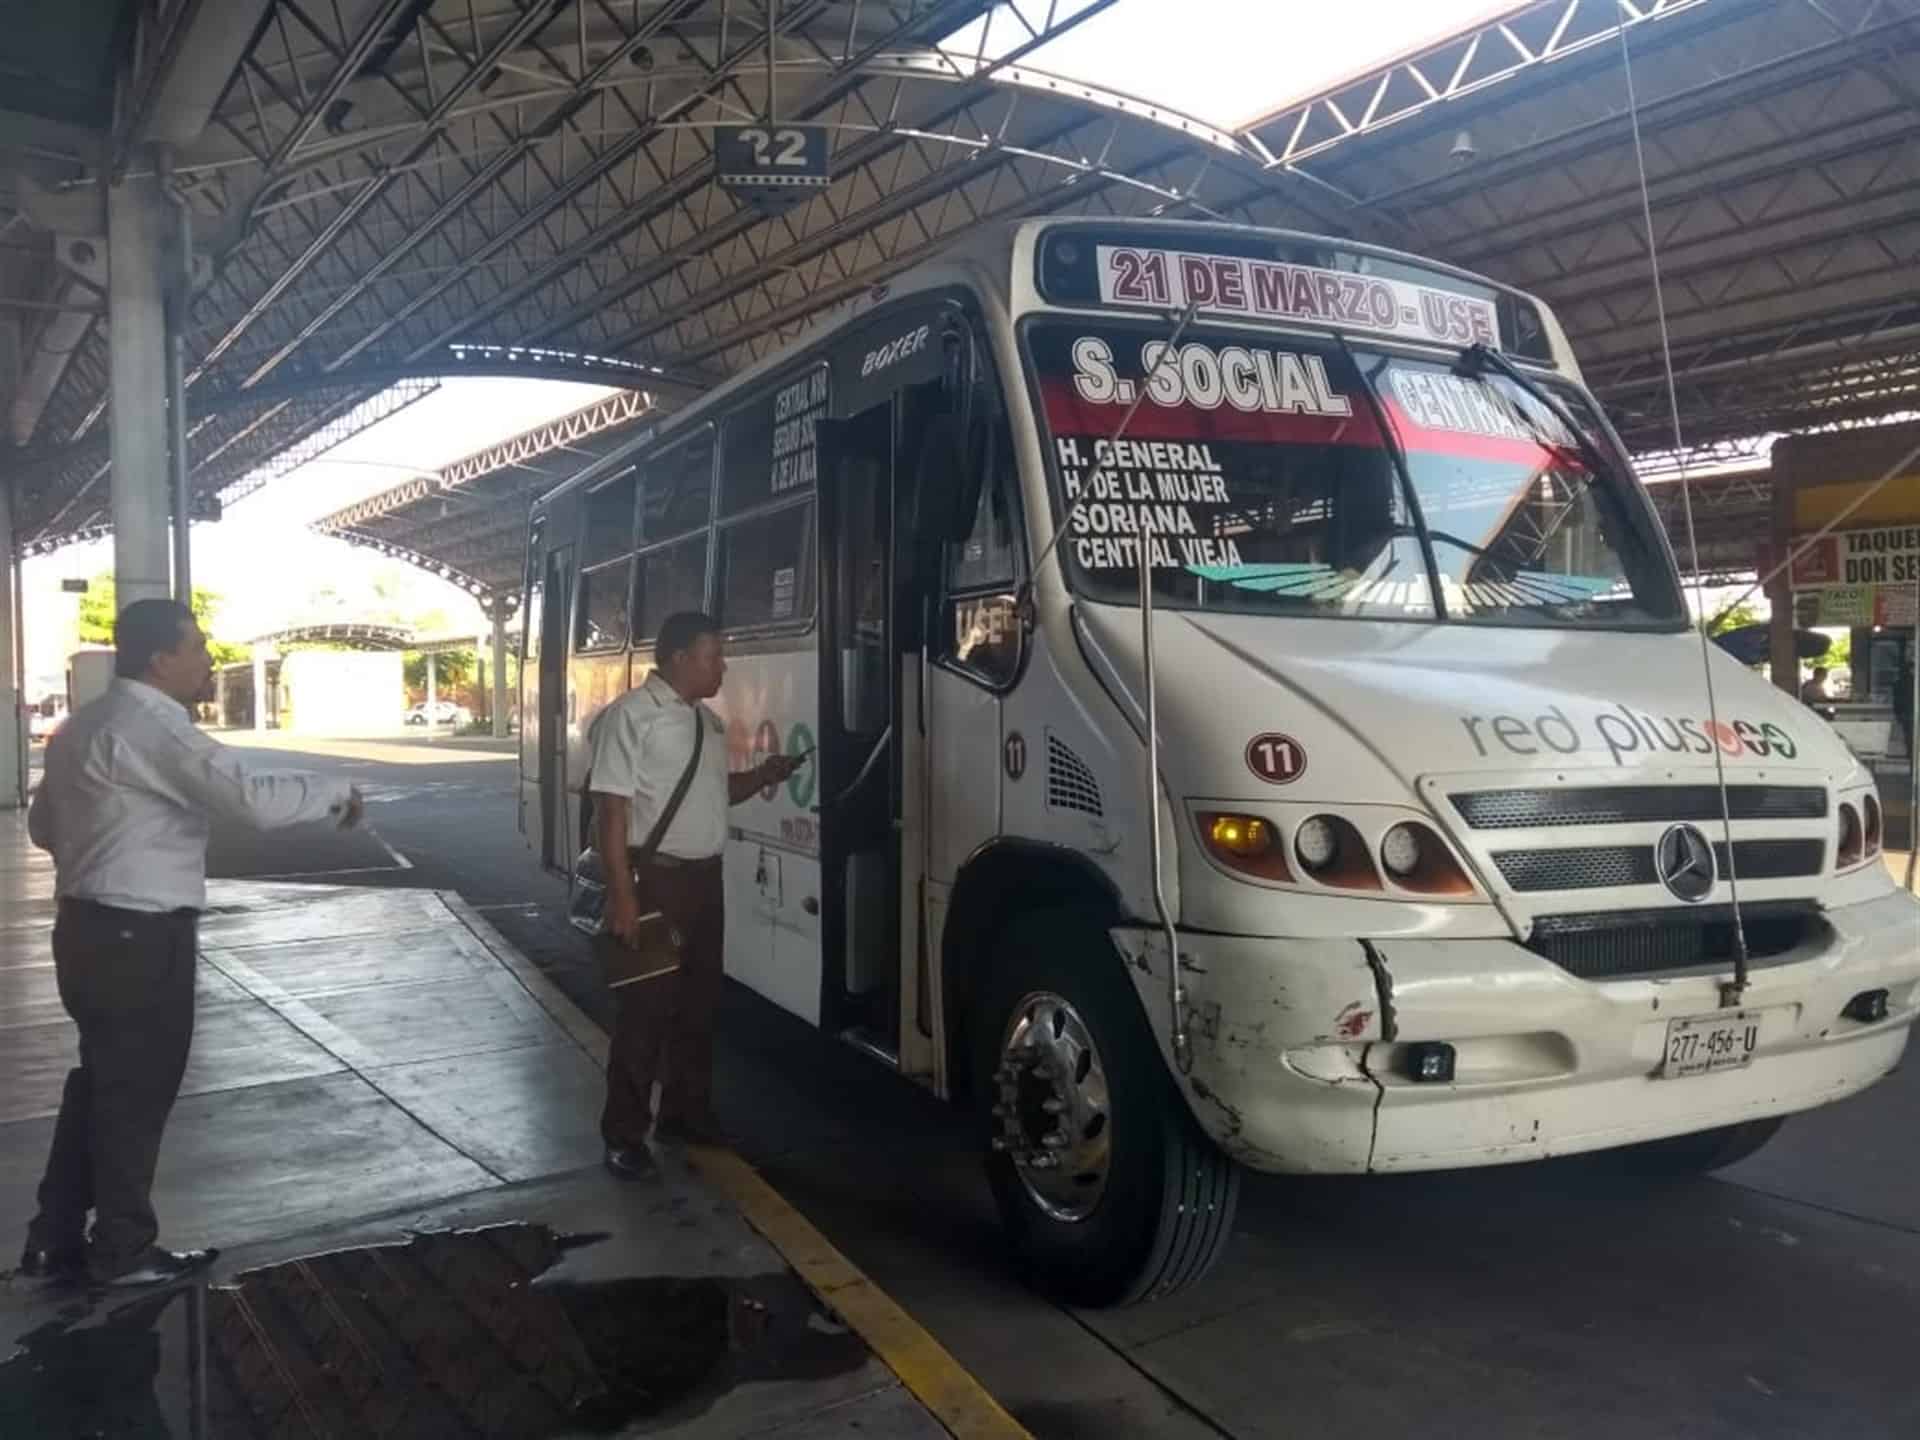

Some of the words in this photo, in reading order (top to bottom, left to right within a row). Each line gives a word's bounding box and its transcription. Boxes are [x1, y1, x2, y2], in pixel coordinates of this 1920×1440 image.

[737, 129, 807, 165] 22
[1111, 249, 1171, 303] 21
[1178, 254, 1248, 310] DE
[862, 324, 929, 376] BOXER
[1072, 336, 1137, 405] S.
[1141, 340, 1353, 417] SOCIAL
[1057, 438, 1088, 467] H.
[1094, 440, 1222, 472] GENERAL
[1064, 470, 1088, 499] H.
[1094, 472, 1122, 499] DE
[1125, 472, 1155, 500] LA
[1156, 474, 1231, 502] MUJER
[1072, 503, 1196, 535] SORIANA
[1178, 538, 1243, 567] VIEJA
[1846, 528, 1920, 553] TAQUE
[1846, 556, 1887, 583] DON
[1893, 552, 1920, 581] SE
[1460, 704, 1580, 757] red
[1595, 704, 1712, 767] plus
[1008, 740, 1023, 771] 11
[1258, 743, 1294, 773] 11
